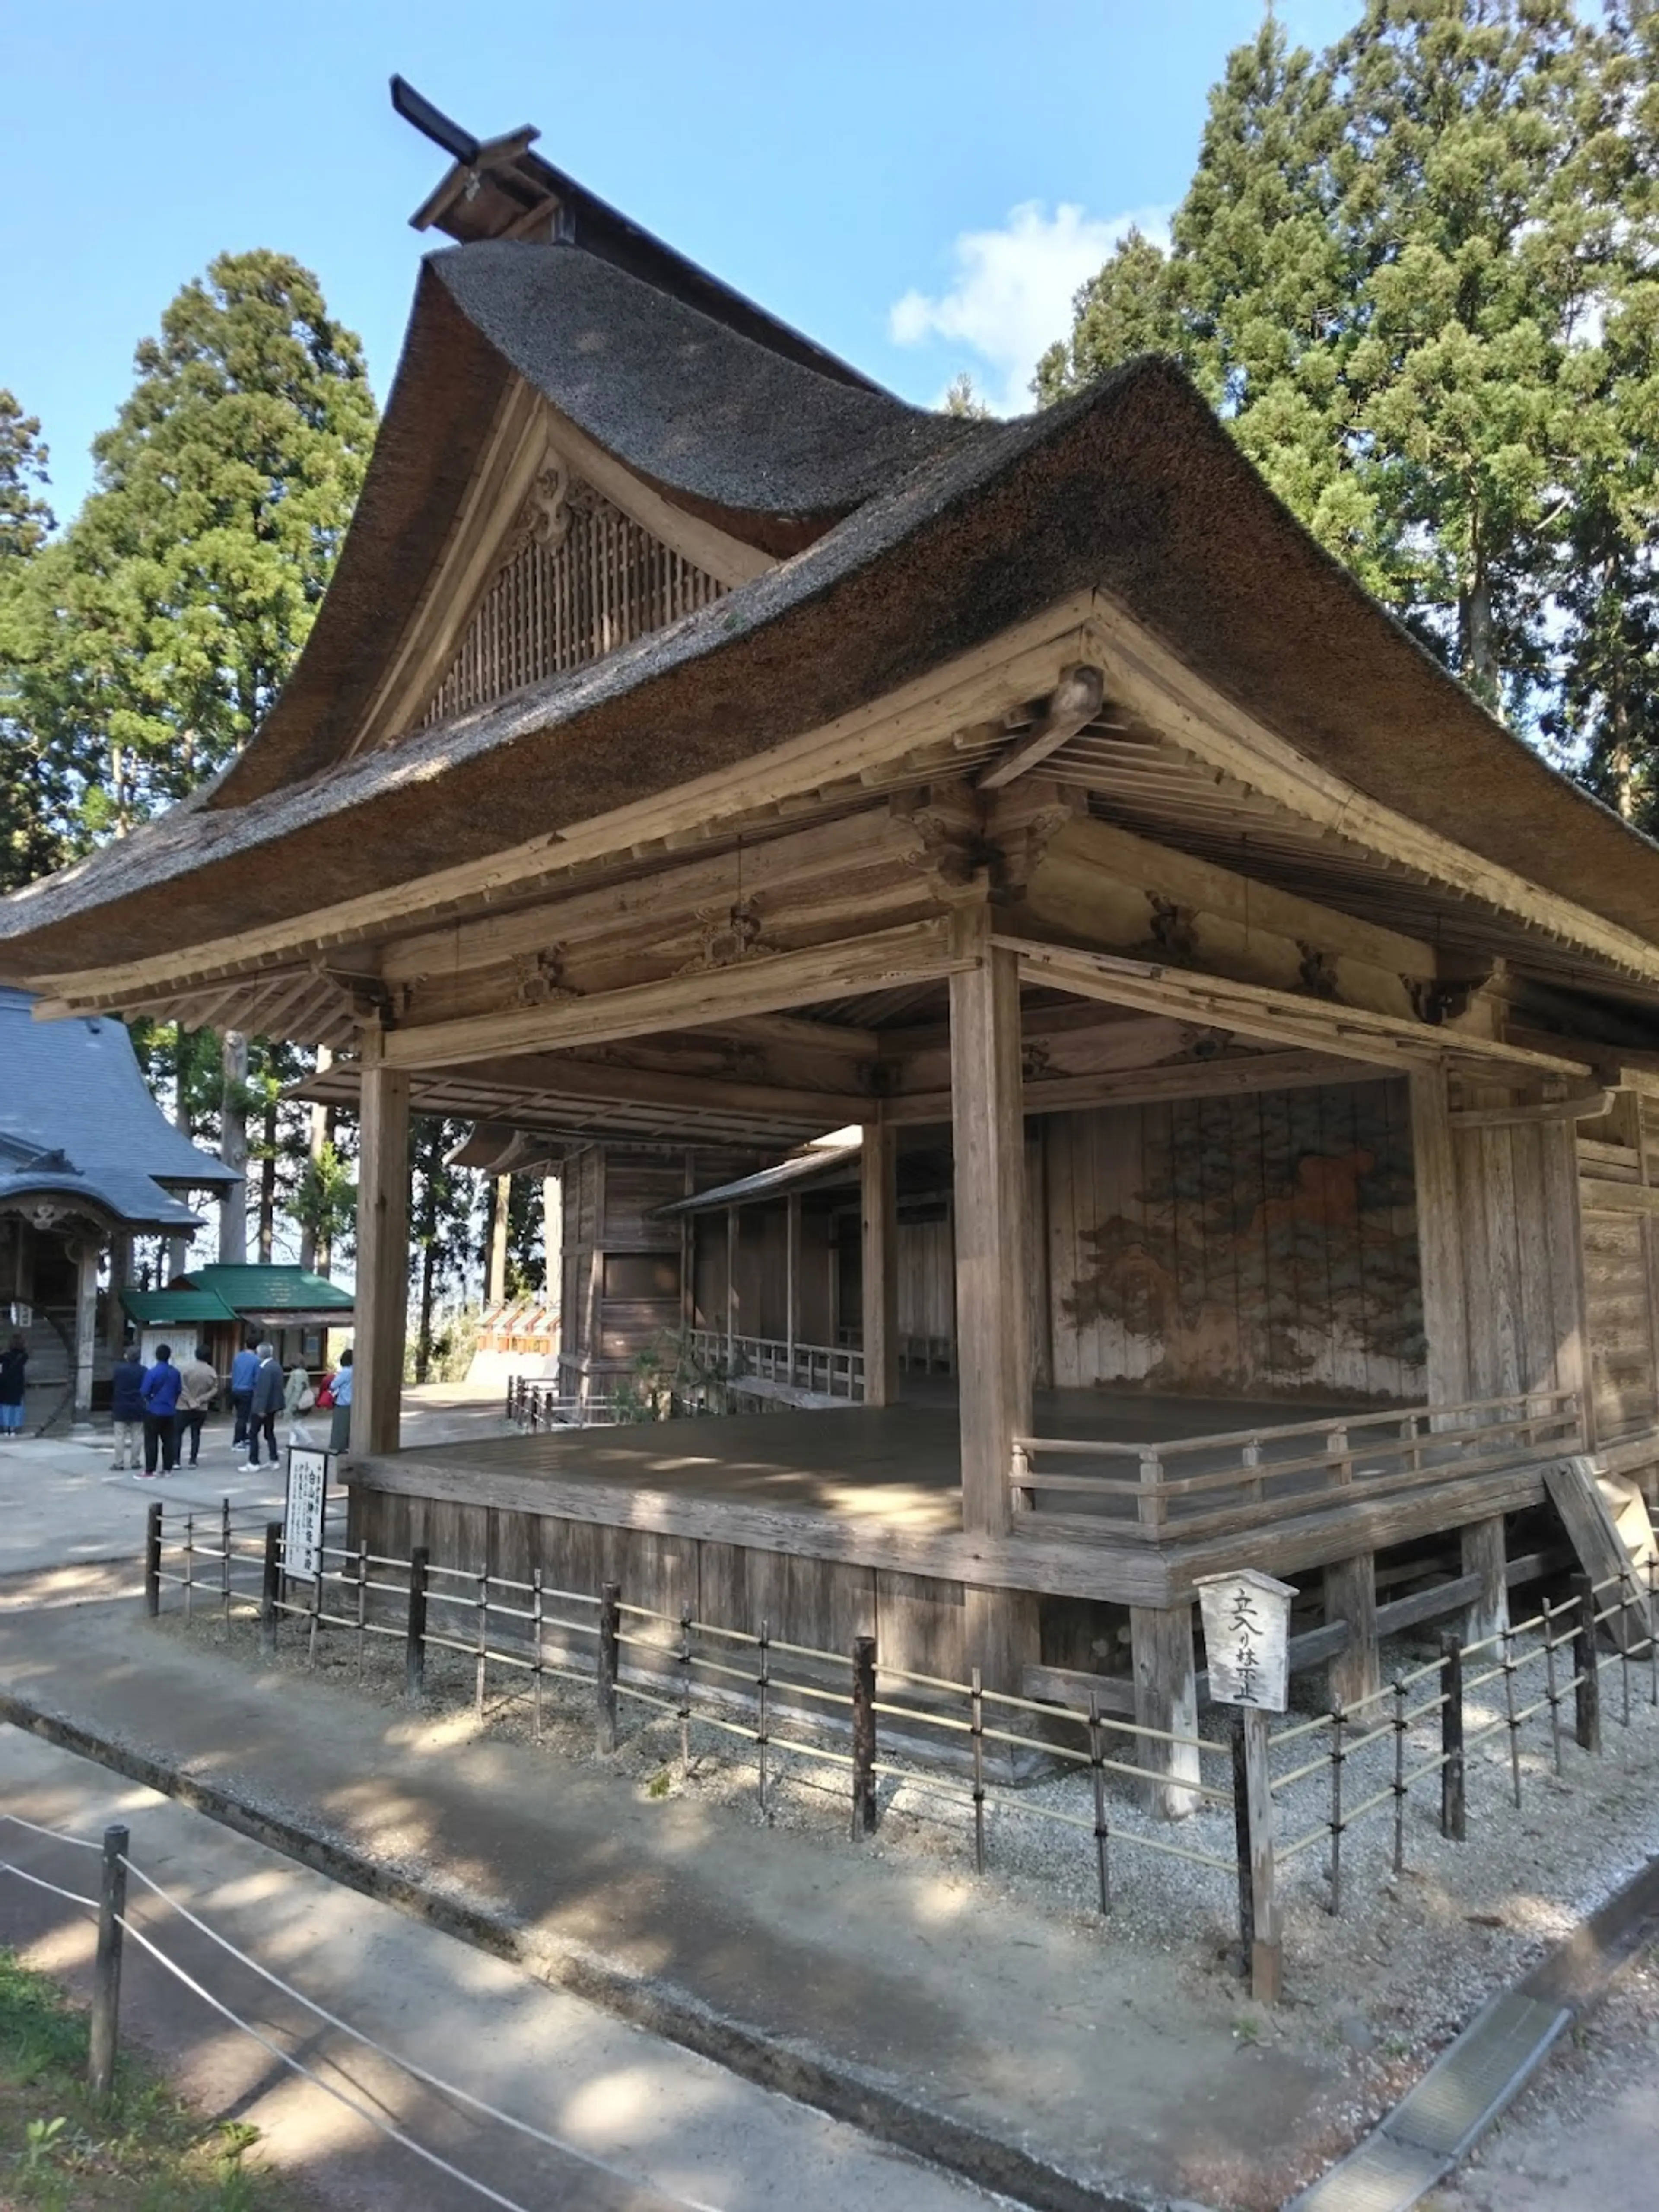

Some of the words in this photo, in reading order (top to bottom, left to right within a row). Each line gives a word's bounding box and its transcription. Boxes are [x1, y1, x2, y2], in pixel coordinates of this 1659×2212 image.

[1228, 1588, 1264, 1703] 立入り禁止
